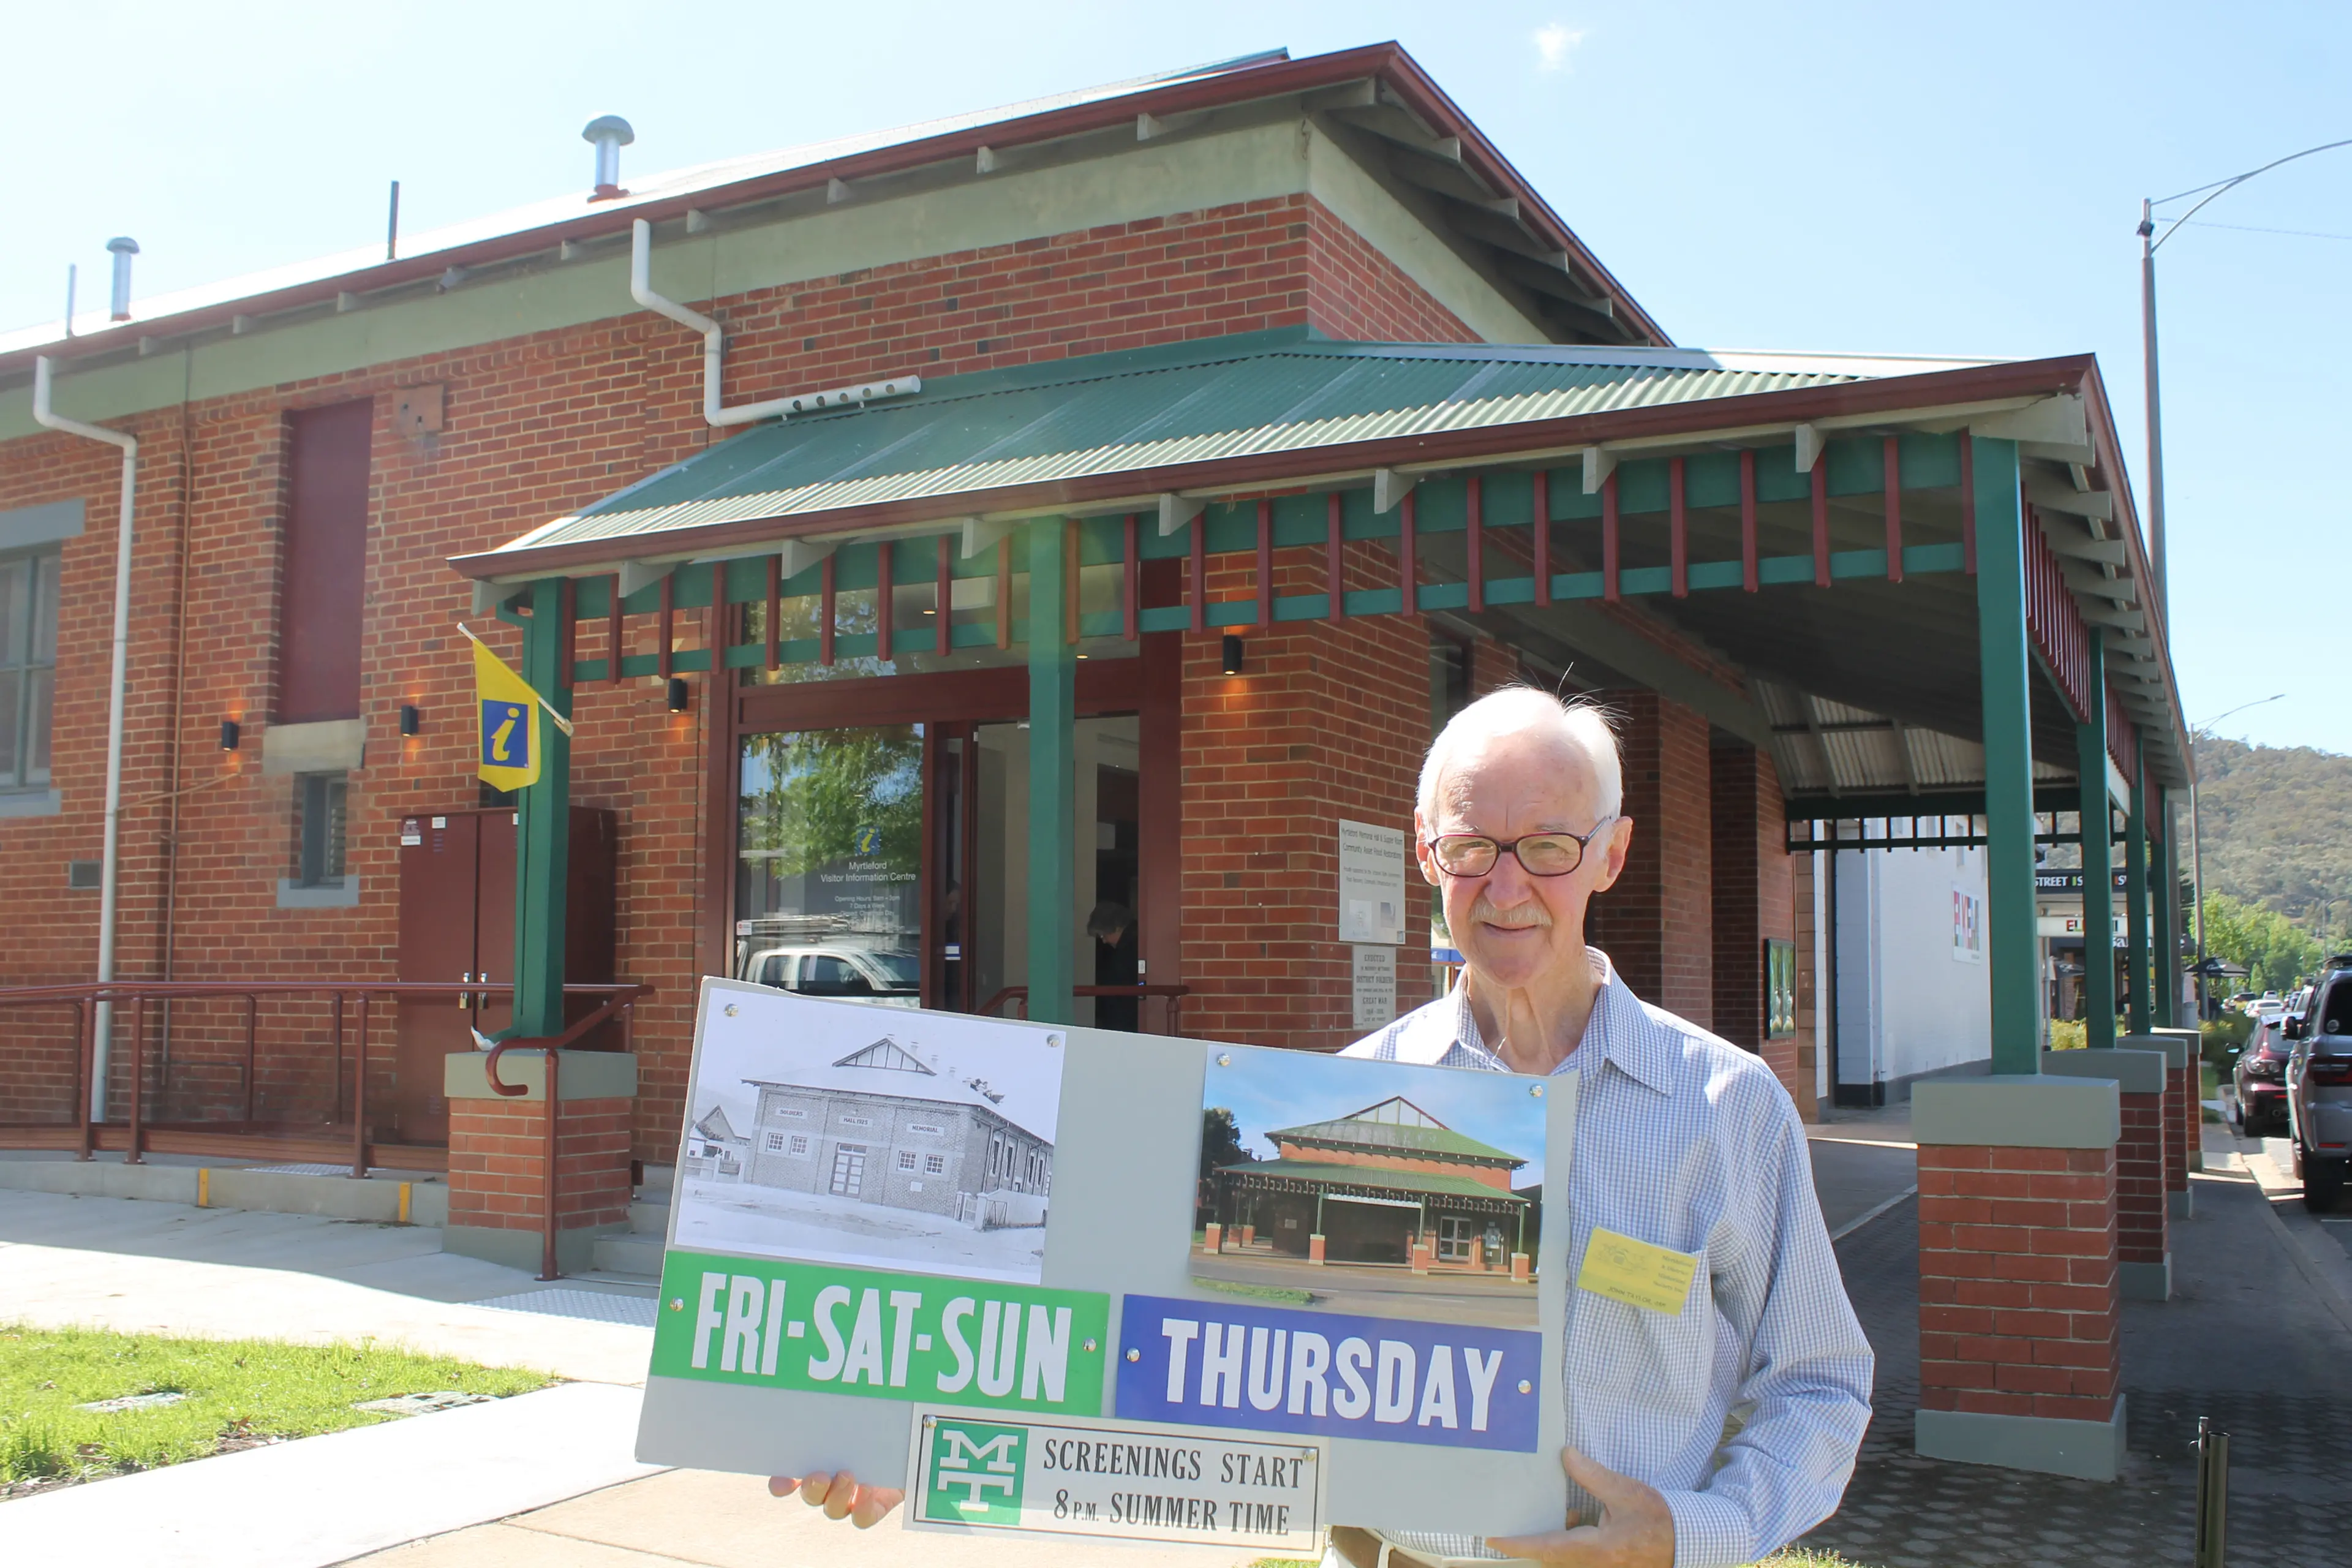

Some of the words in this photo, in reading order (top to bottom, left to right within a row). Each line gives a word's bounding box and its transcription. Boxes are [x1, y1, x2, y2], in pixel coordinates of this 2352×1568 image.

[845, 873, 888, 882] Information
[890, 872, 916, 881] Centre
[849, 861, 887, 872] Myrtleford
[692, 1272, 1072, 1403] FRI-SAT-SUN
[1162, 1317, 1504, 1431] THURSDAY
[1044, 1439, 1201, 1481] SCREENINGS
[1221, 1453, 1303, 1488] START
[1110, 1493, 1217, 1531] SUMMER
[1229, 1502, 1290, 1536] TIME
